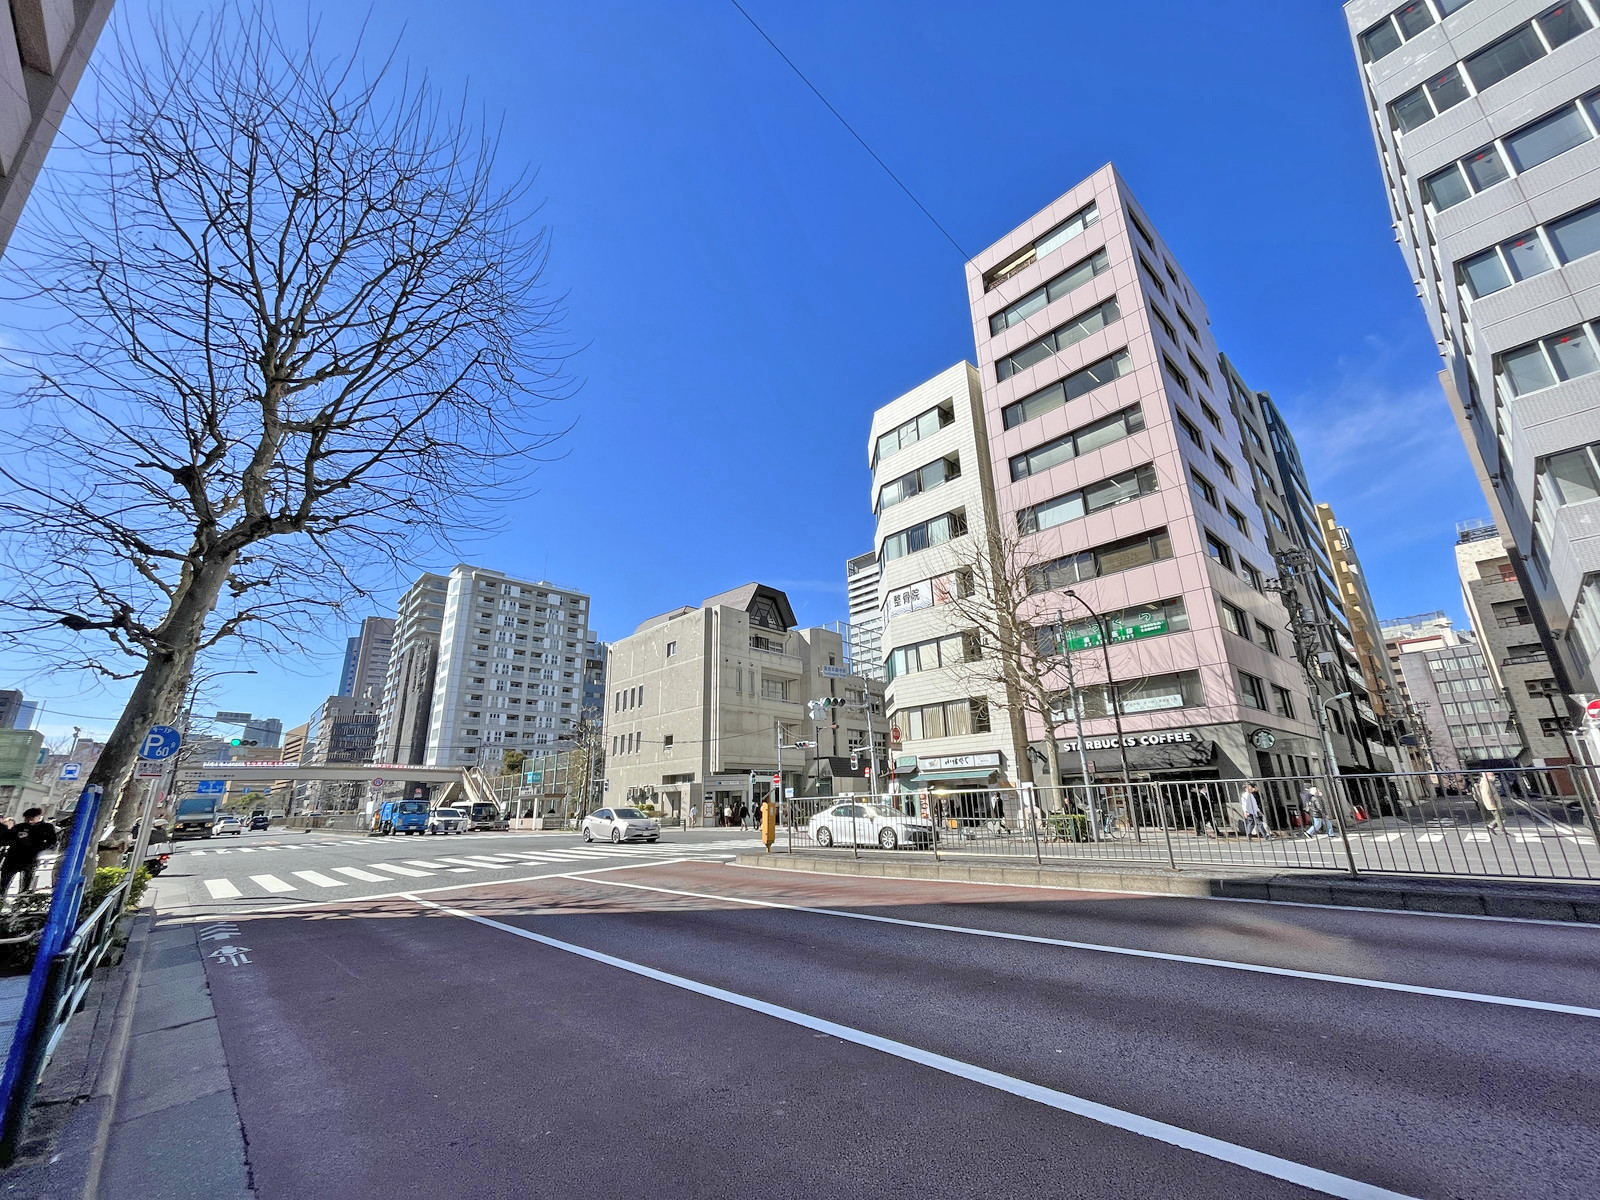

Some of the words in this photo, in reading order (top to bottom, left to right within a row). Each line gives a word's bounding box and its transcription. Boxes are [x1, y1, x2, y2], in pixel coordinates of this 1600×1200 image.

[143, 734, 165, 756] P
[1140, 731, 1192, 747] COFFEE
[155, 746, 169, 757] 60
